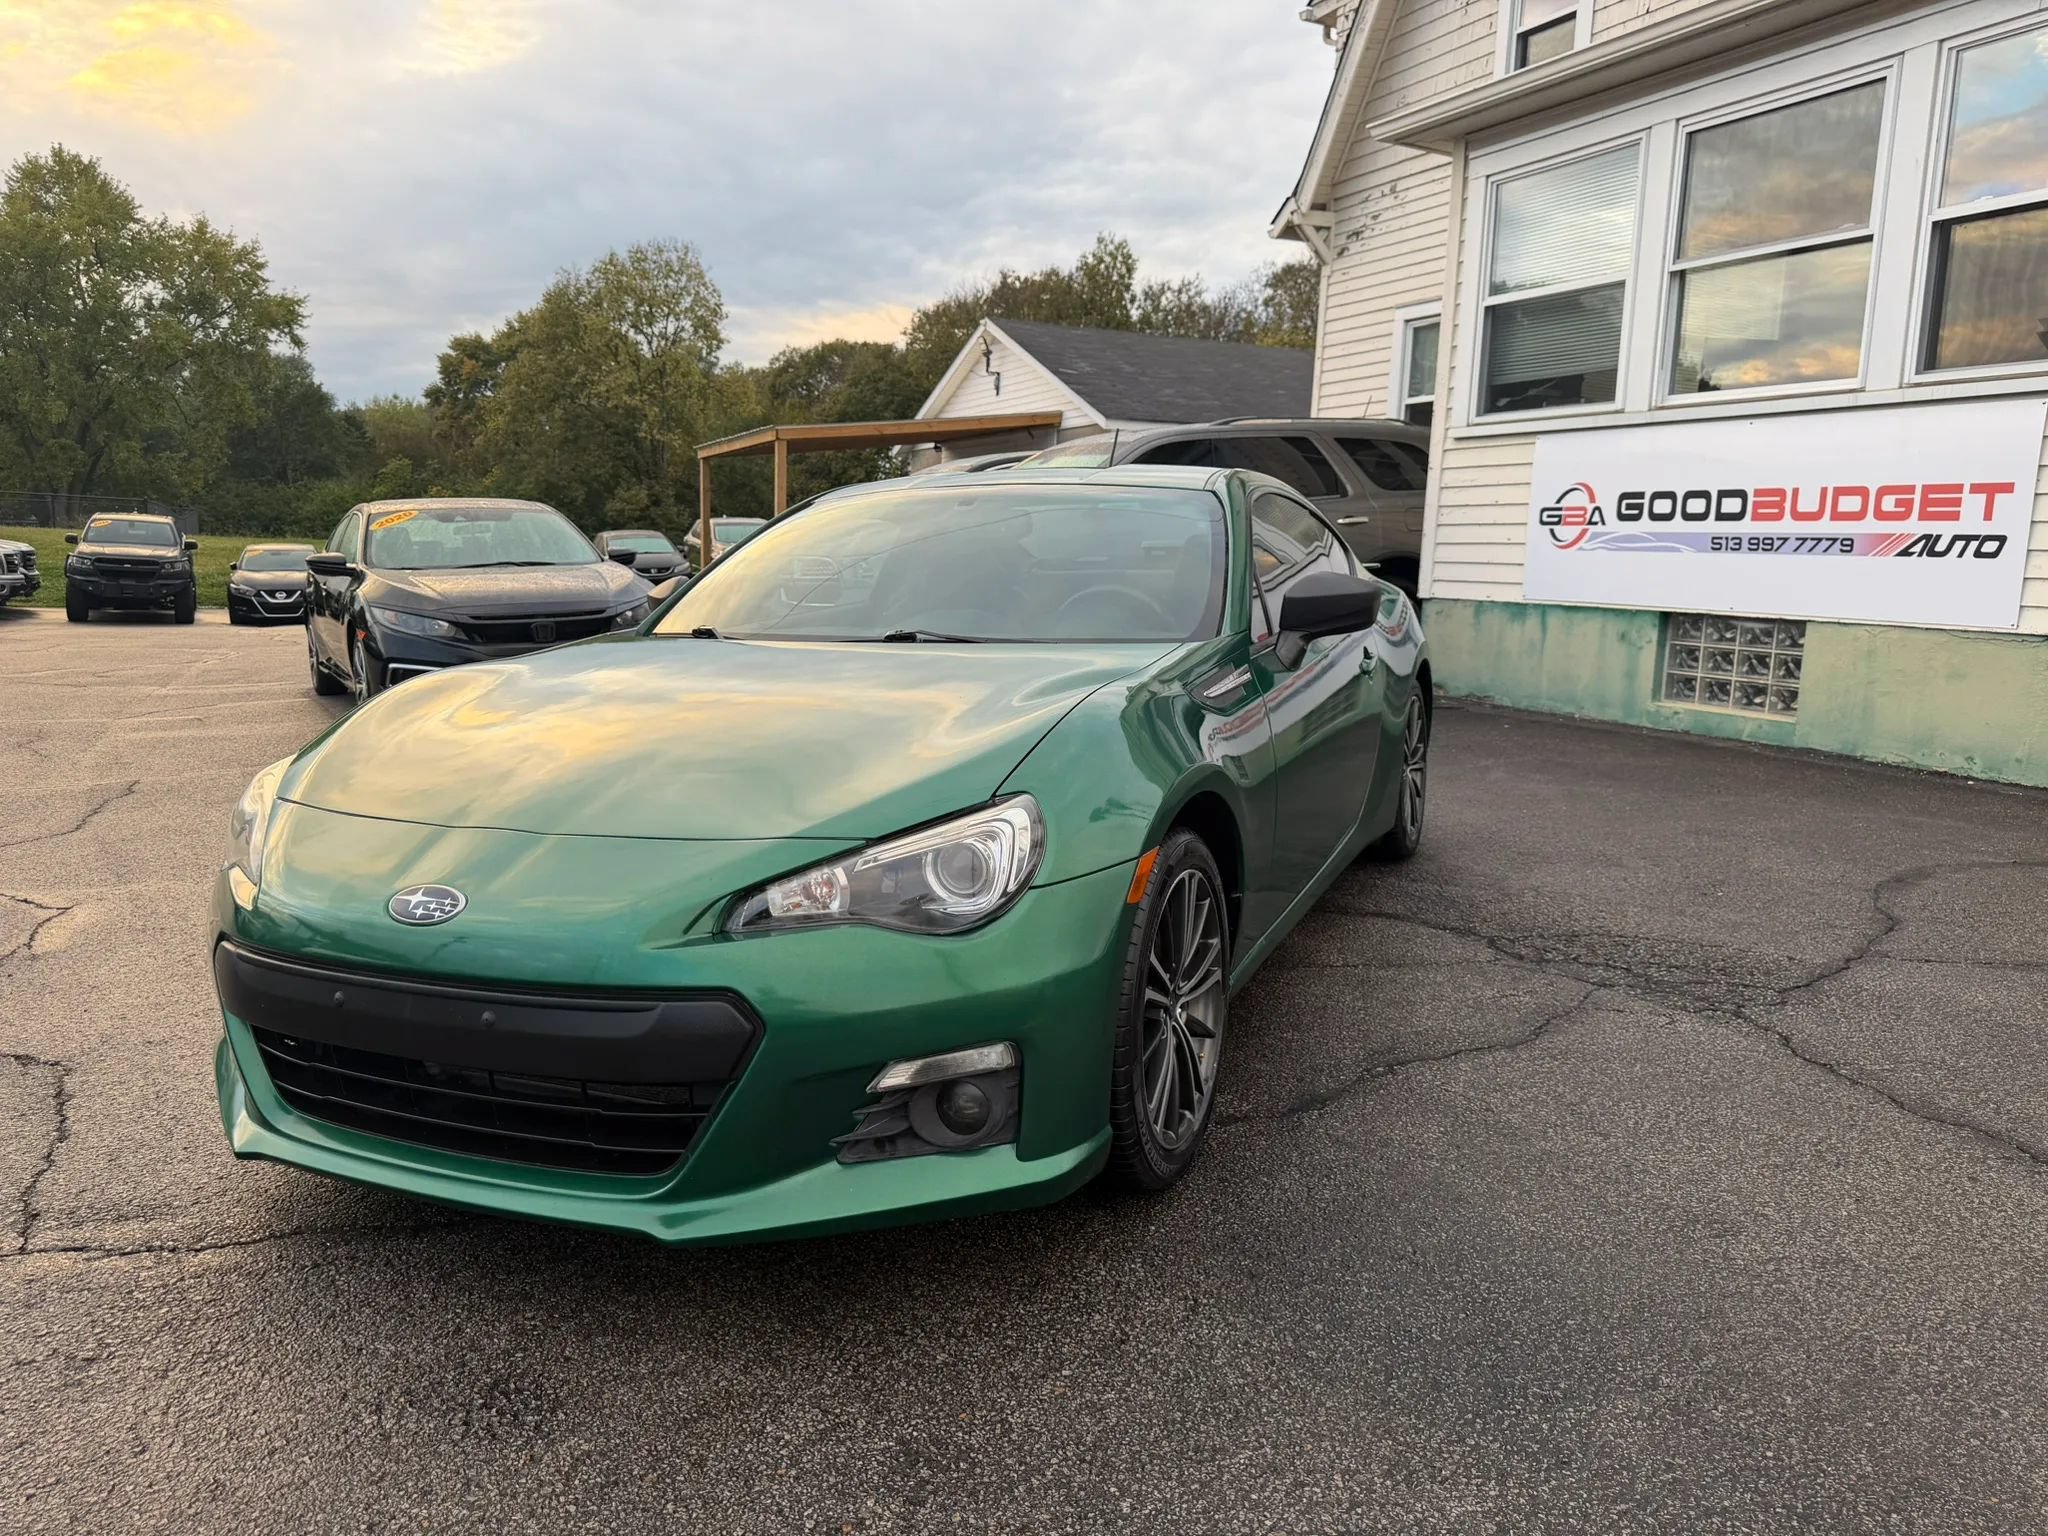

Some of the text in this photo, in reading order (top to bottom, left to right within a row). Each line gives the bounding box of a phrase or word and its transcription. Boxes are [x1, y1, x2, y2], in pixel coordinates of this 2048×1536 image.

[375, 511, 413, 528] 2020
[1539, 505, 1606, 526] GBA
[1710, 536, 1855, 553] 513 997 7779
[1893, 534, 2008, 559] AUTO
